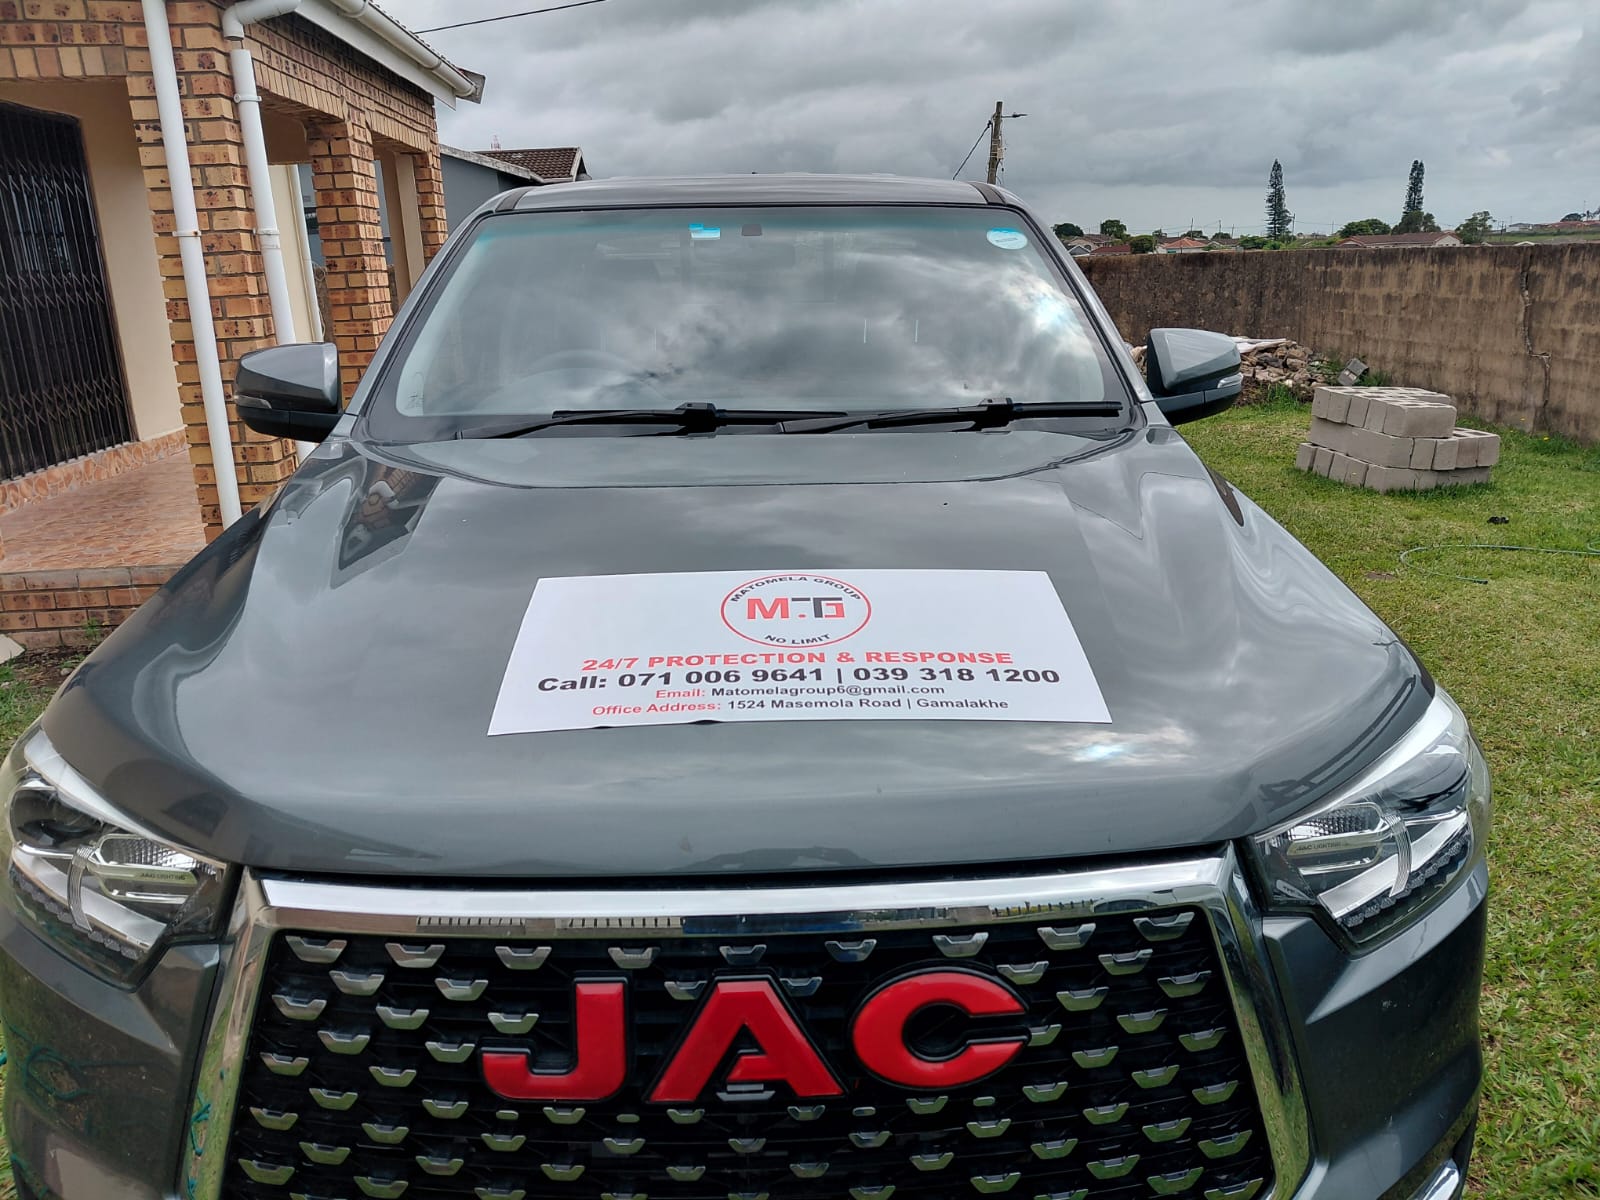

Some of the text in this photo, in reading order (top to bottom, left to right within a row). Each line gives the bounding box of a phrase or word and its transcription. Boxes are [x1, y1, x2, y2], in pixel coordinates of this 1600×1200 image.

[730, 576, 861, 602] MATOMELA GROUP
[764, 633, 831, 645] NO LIMIT
[581, 652, 1014, 671] 24/7 PROTECTION & RESPONSE
[537, 675, 607, 692] Call:
[618, 672, 672, 687] 071
[685, 670, 741, 685] 006
[751, 668, 823, 683] 9641
[853, 668, 909, 682] 039
[919, 668, 975, 682] 318
[985, 668, 1060, 684] 1200
[655, 685, 945, 699] Email: Matomelagroup6@gmail.com
[592, 704, 642, 716] Office
[646, 702, 721, 713] Address:
[727, 700, 765, 710] 1524
[771, 698, 853, 709] Masemola
[859, 698, 902, 708] Road
[916, 698, 1009, 709] Gamalakhe
[480, 968, 1029, 1102] JAC
